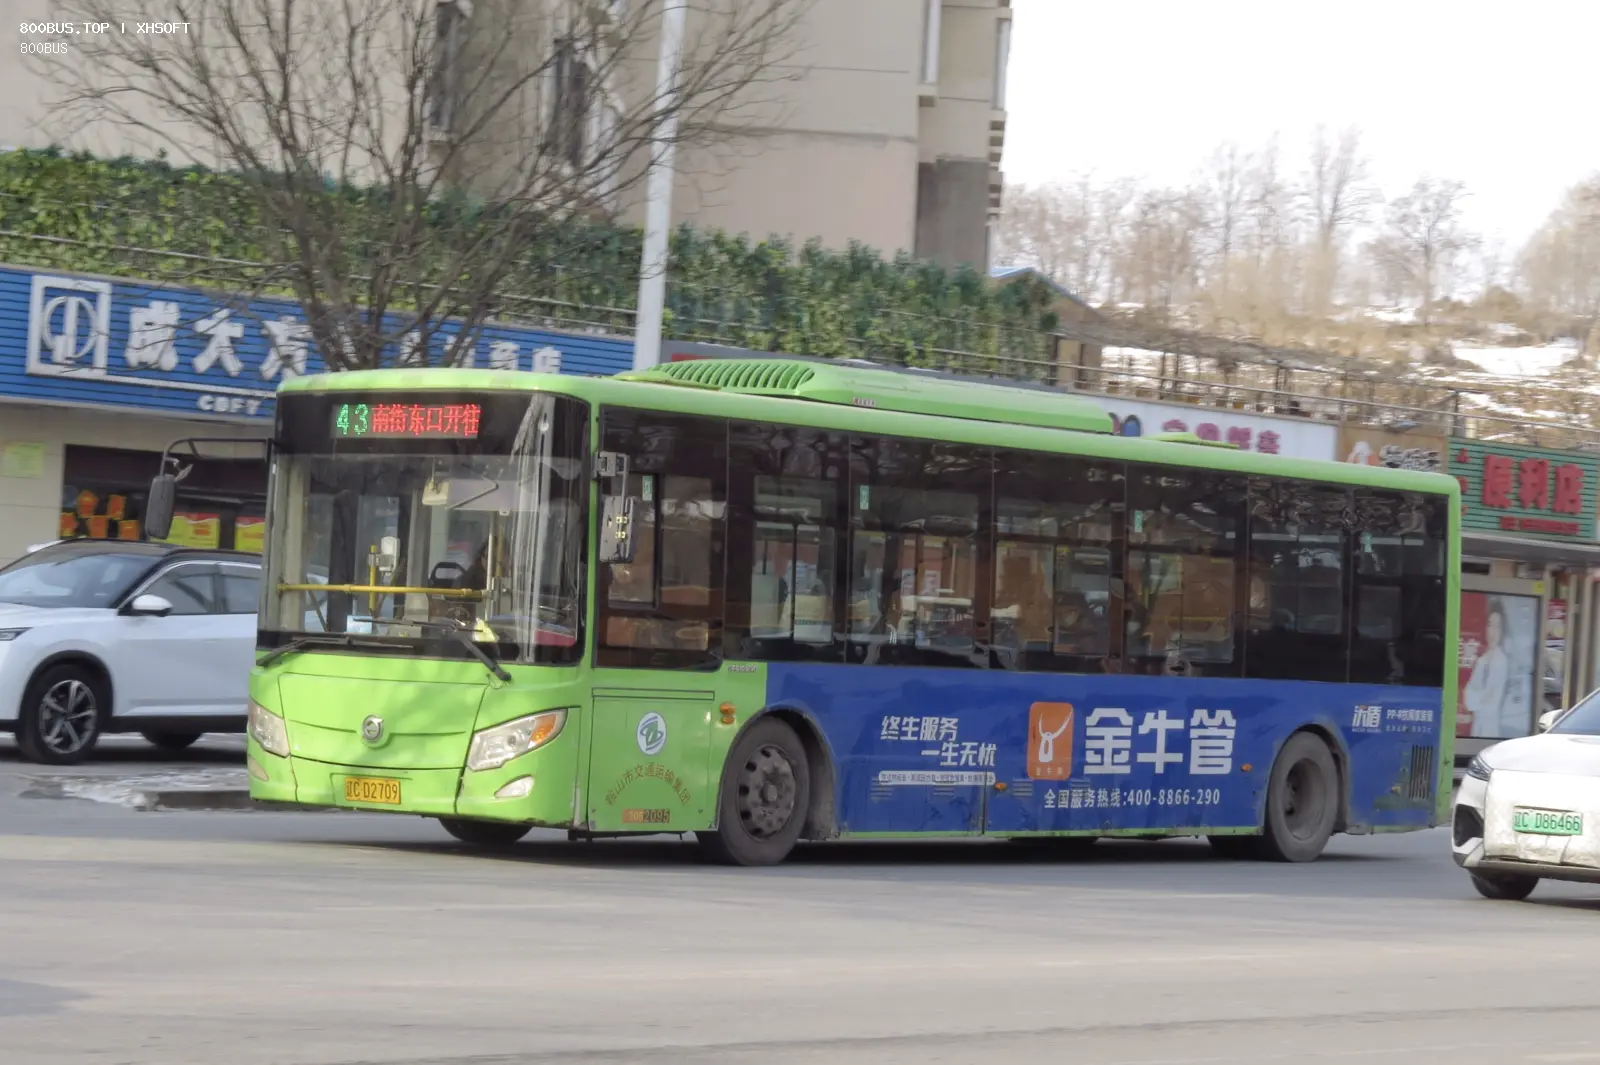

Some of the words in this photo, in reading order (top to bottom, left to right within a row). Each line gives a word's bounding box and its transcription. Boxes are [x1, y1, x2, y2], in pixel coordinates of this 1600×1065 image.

[336, 404, 369, 435] 43
[371, 404, 482, 436] 南街东口开往
[880, 715, 959, 741] 终生服务
[1084, 708, 1236, 774] 金牛管
[921, 742, 997, 767] 一生无忧
